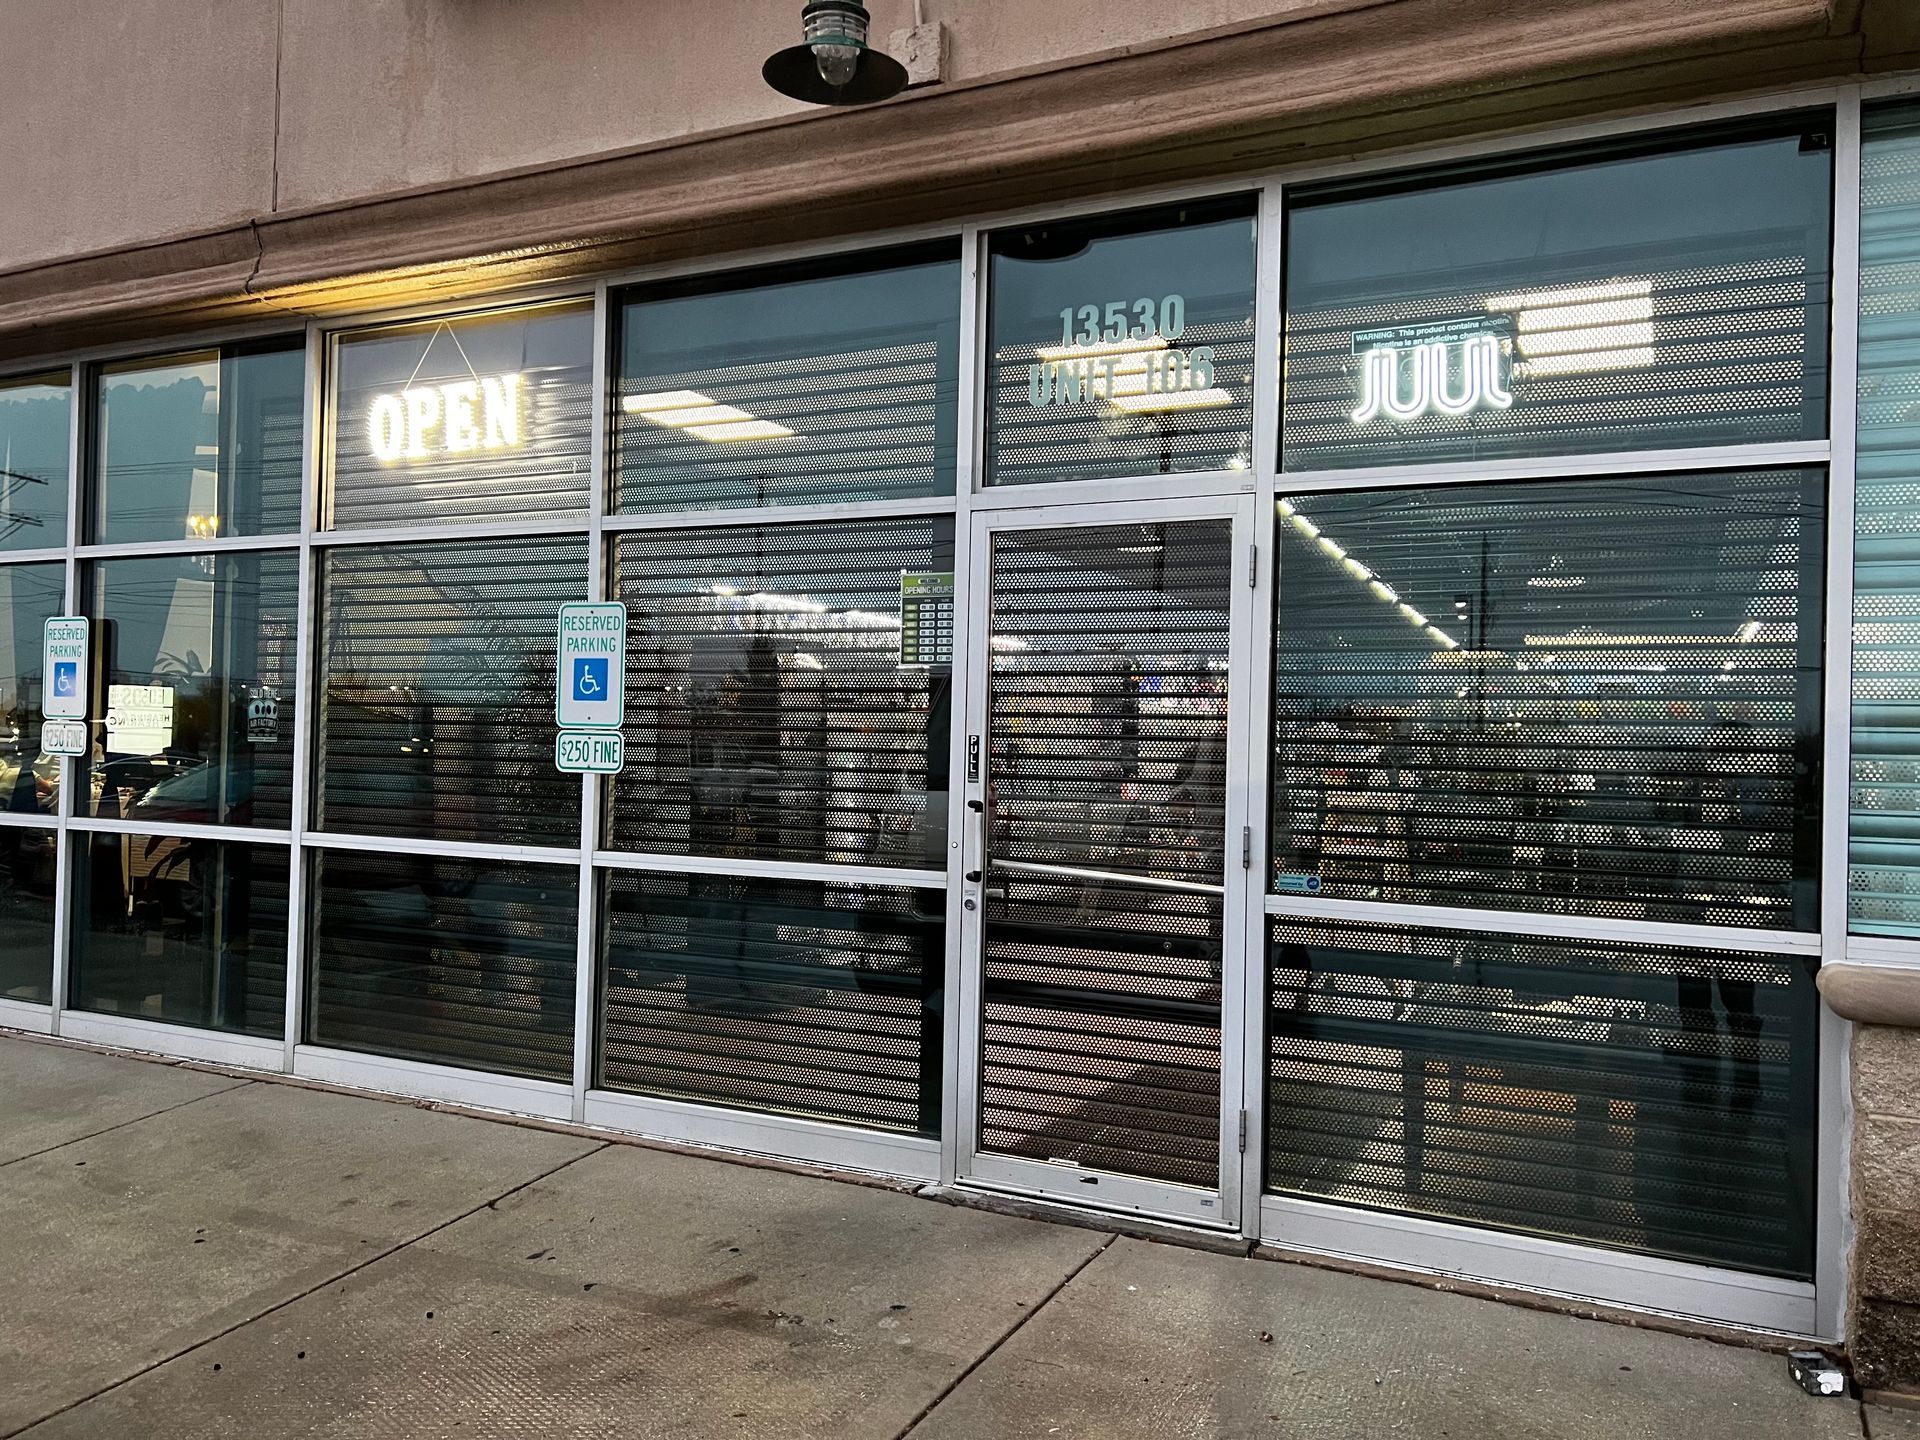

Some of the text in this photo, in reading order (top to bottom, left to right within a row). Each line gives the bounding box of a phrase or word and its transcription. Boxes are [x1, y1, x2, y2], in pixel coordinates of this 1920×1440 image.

[1060, 294, 1185, 348] 13530
[1355, 331, 1395, 342] WARNING:
[1399, 328, 1415, 337] This
[1416, 324, 1446, 336] product
[1447, 321, 1480, 331] contains
[1404, 338, 1412, 346] is
[1413, 337, 1423, 345] an
[1424, 333, 1458, 344] addictive
[1029, 346, 1215, 407] UNIT 106
[1352, 335, 1513, 422] JUUL
[367, 373, 523, 461] OPEN
[904, 585, 954, 595] OPENING HOURS
[563, 616, 621, 631] RESERVED
[48, 628, 85, 641] RESERVED
[50, 645, 82, 658] PARKING
[567, 637, 616, 653] PARKING
[45, 729, 83, 748] $250 FINE
[561, 740, 618, 764] $250 FINE
[970, 735, 978, 772] PULL
